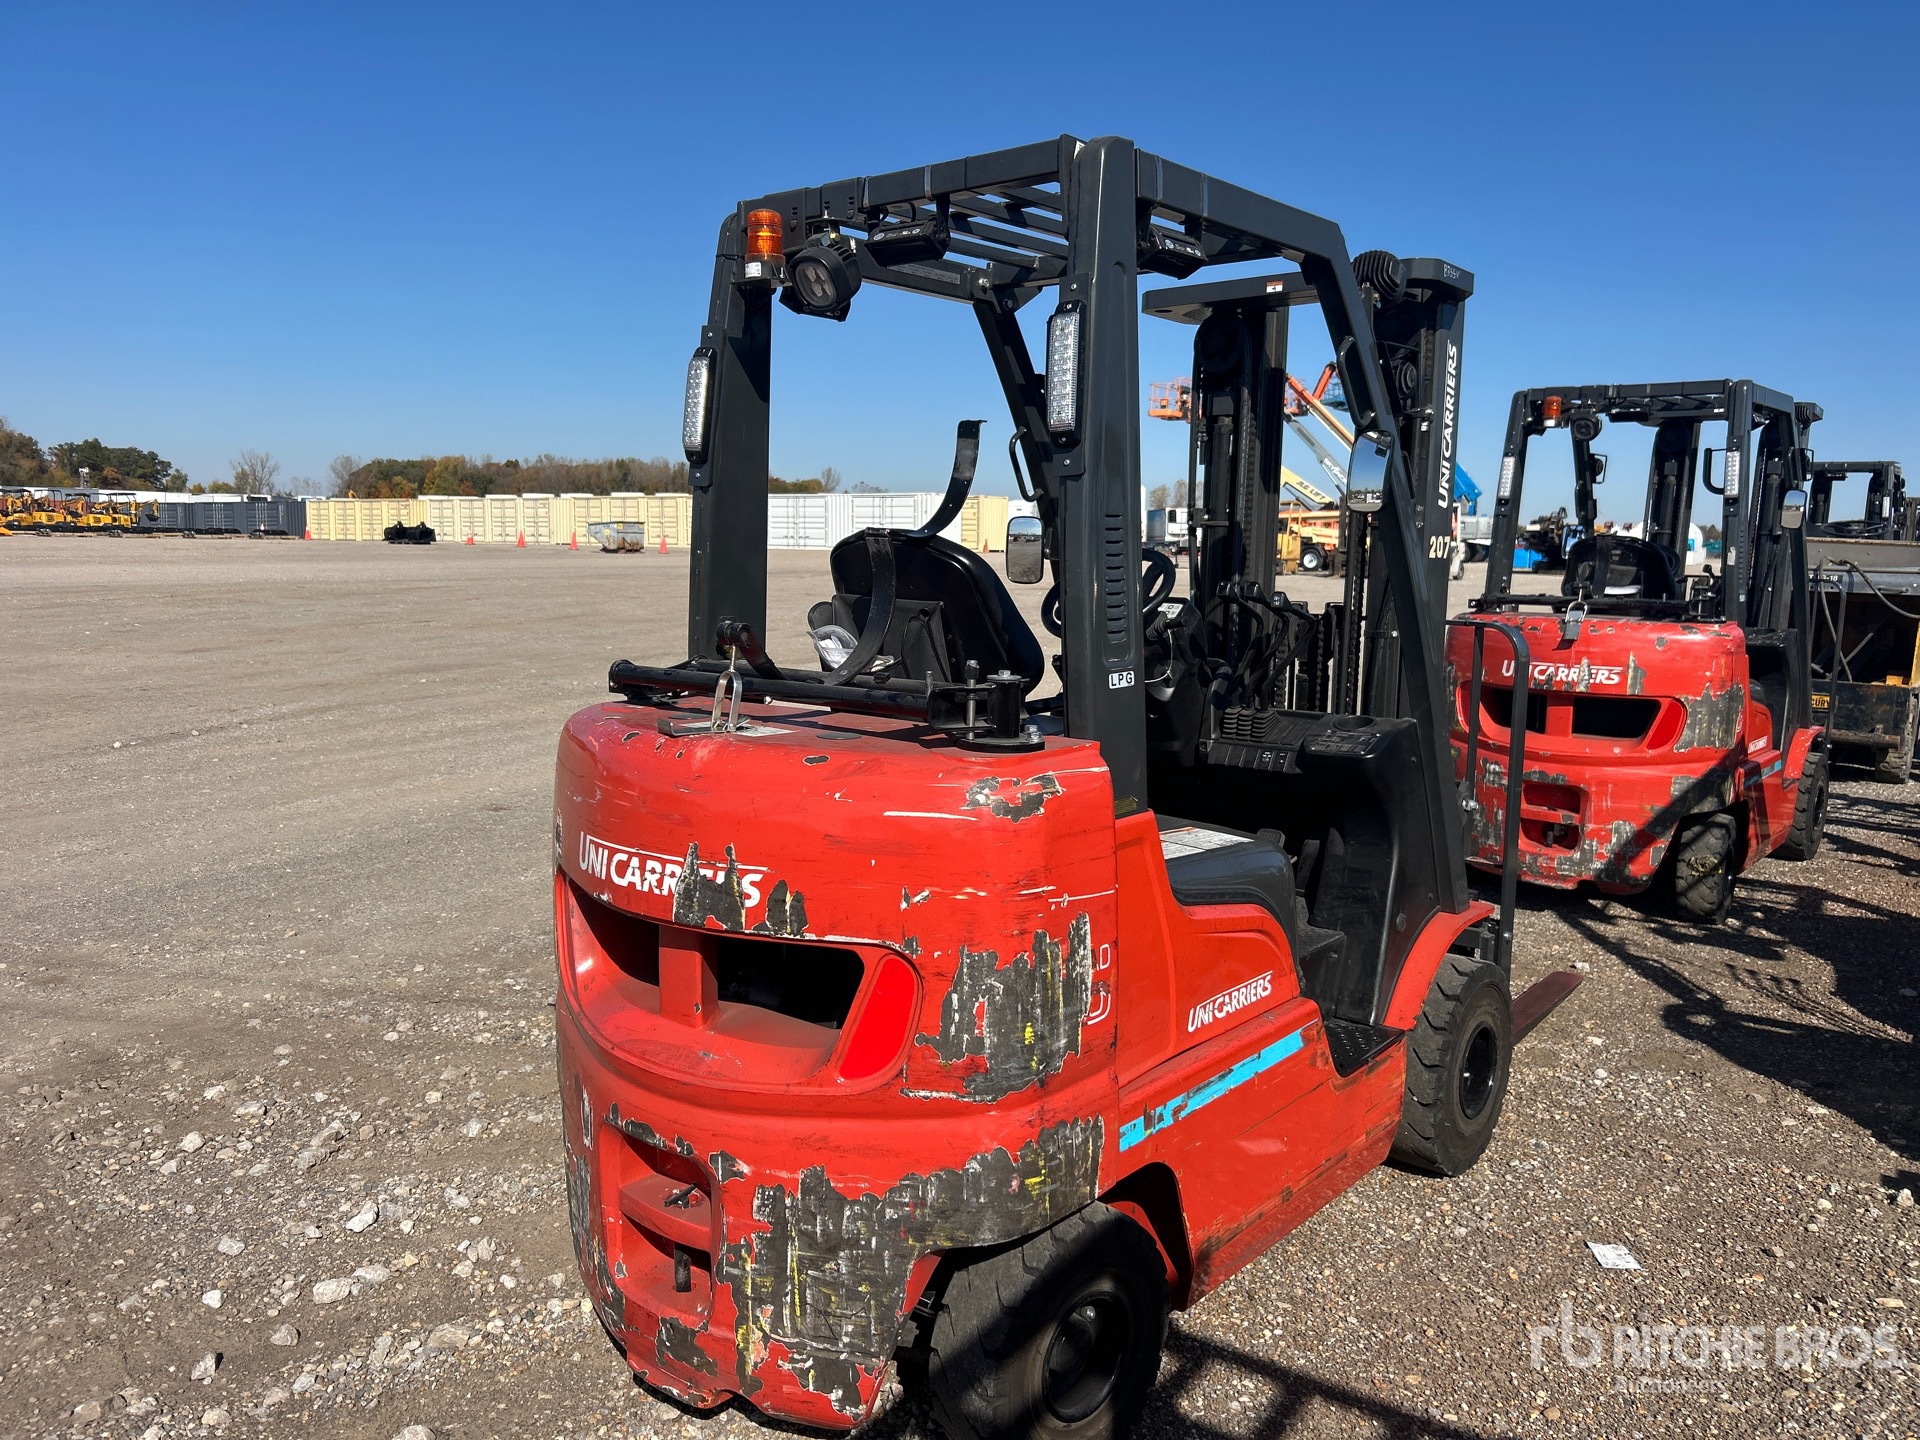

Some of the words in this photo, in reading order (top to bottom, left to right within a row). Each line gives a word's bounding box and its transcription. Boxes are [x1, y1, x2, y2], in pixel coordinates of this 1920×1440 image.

[1296, 480, 1310, 491] JLG
[1309, 487, 1326, 500] LIFT
[1428, 535, 1451, 559] 207
[1110, 672, 1132, 687] LPG
